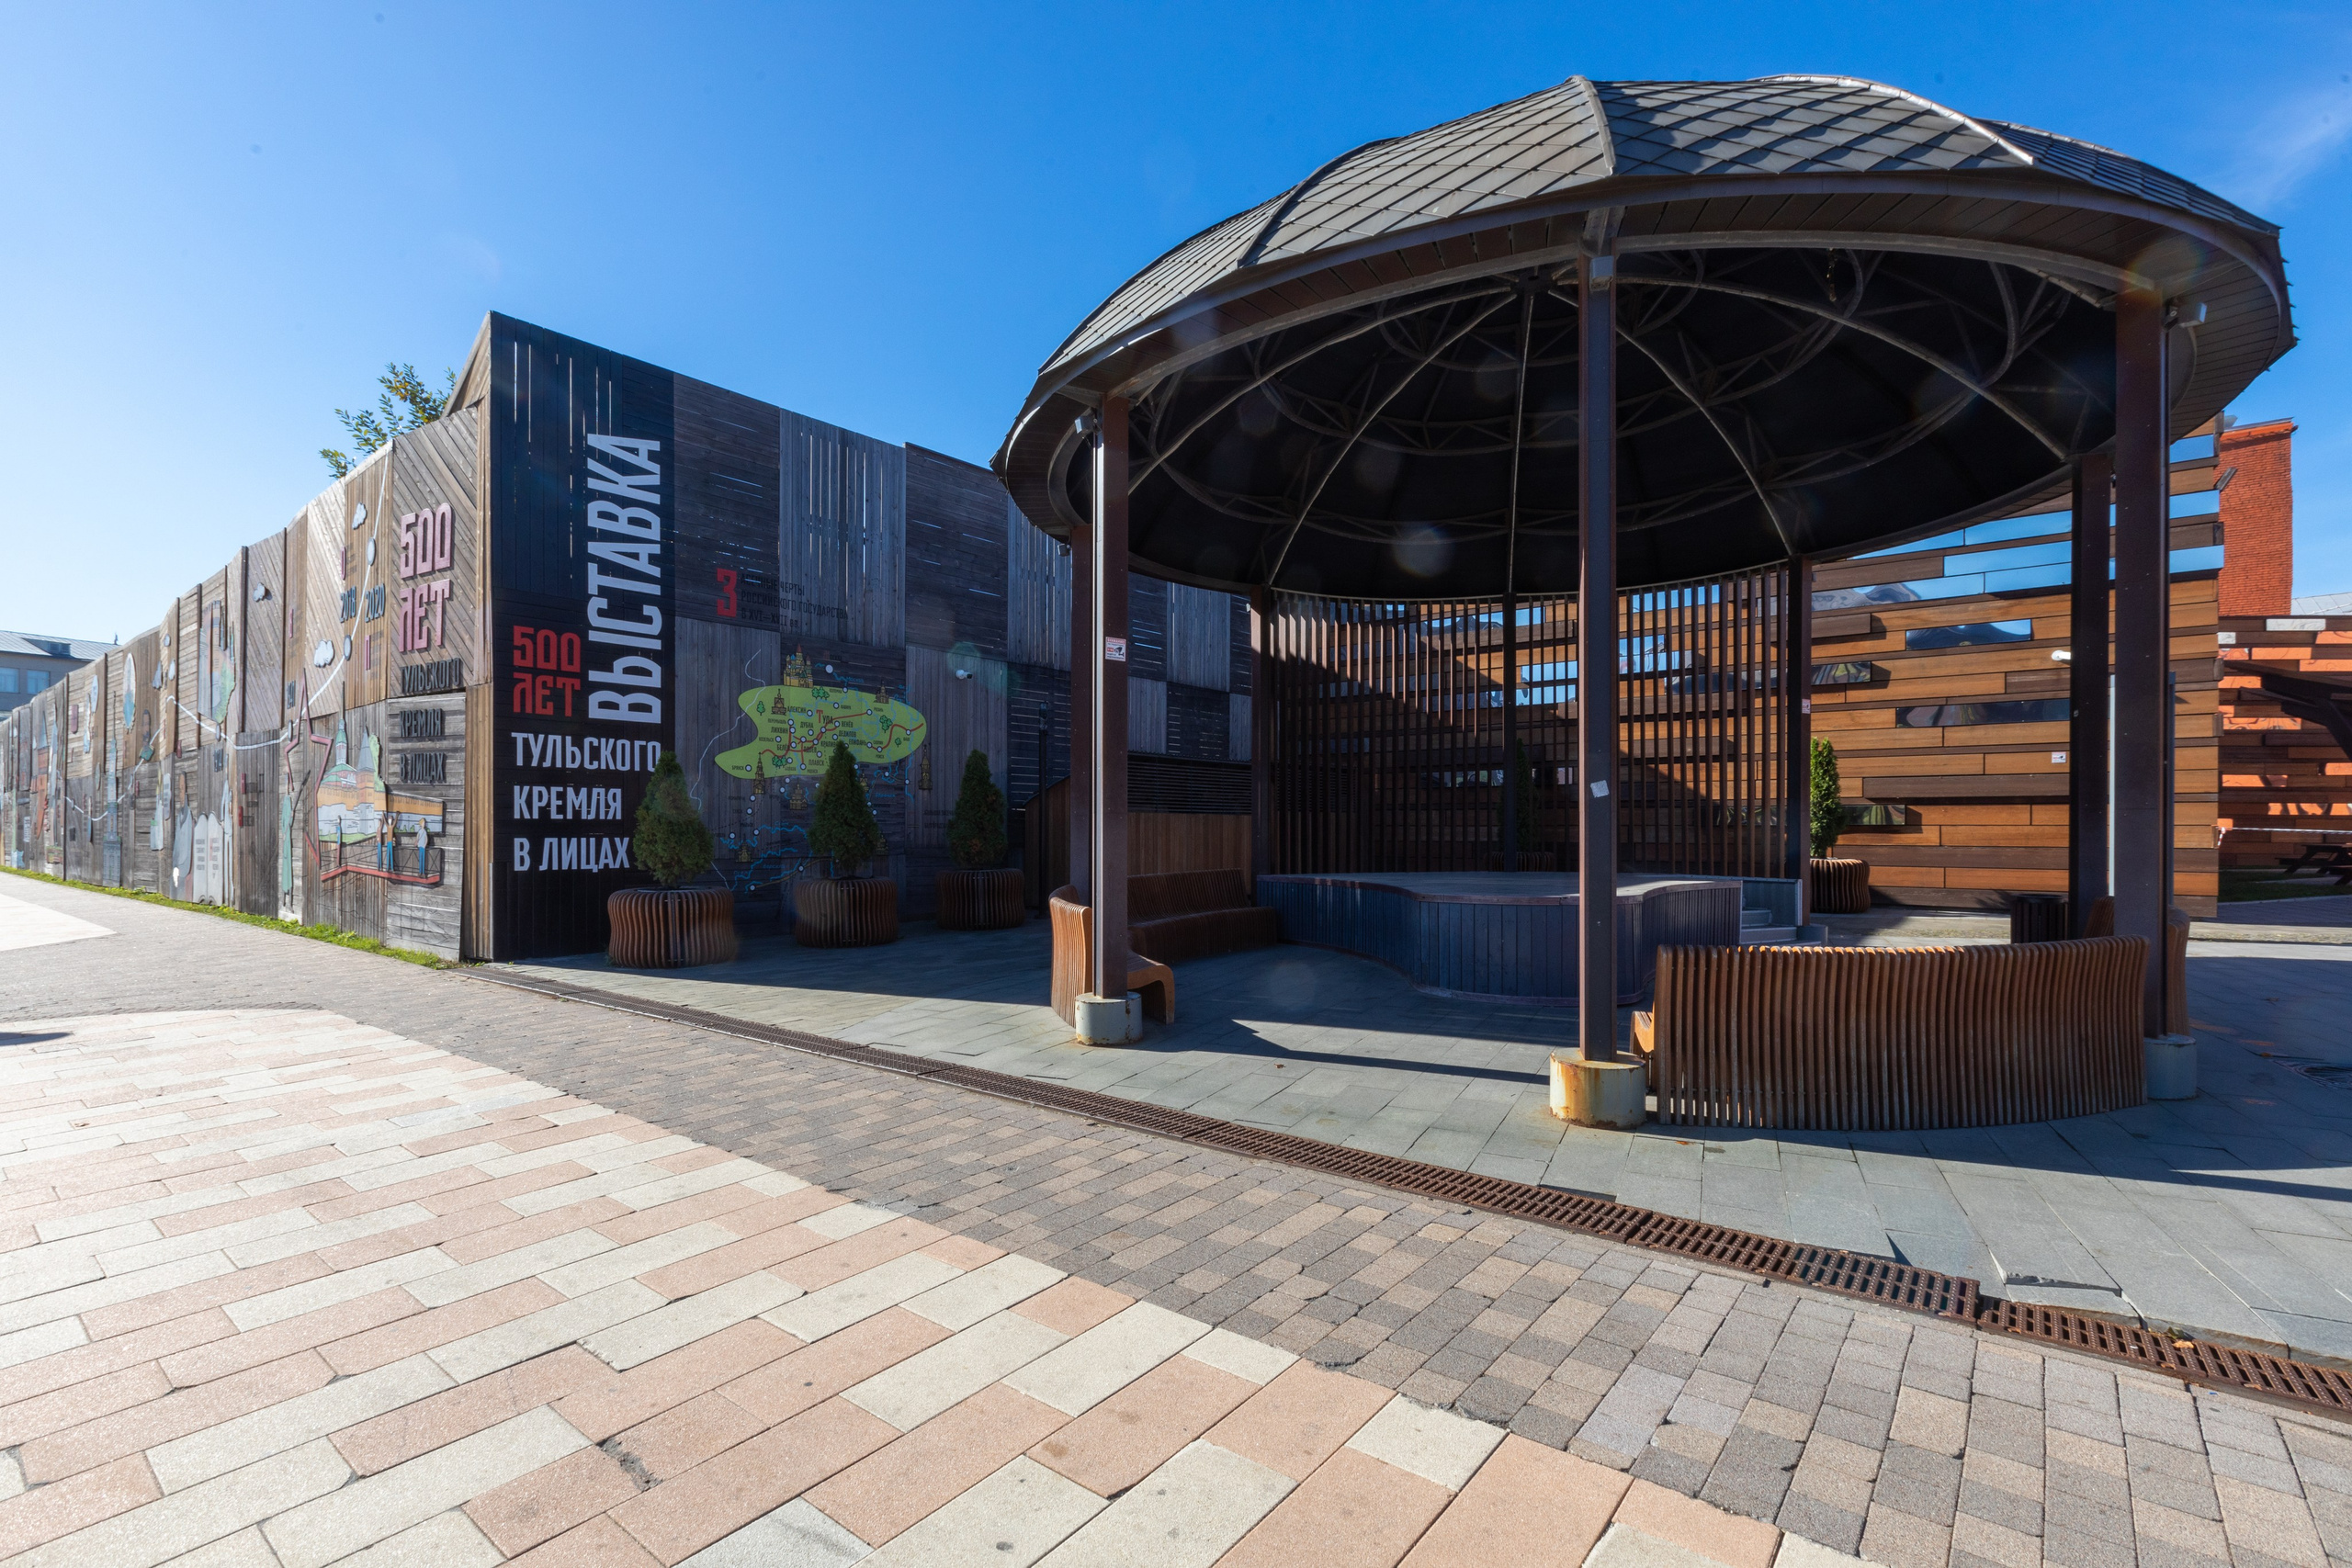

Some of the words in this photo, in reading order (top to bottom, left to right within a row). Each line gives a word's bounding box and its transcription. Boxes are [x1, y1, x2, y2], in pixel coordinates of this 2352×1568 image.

[400, 502, 453, 580] 500
[586, 433, 662, 724] ВЫСТАВКА
[781, 581, 805, 596] ЧЕРТЫ
[340, 585, 356, 624] 2018
[365, 582, 385, 623] 2020
[399, 578, 451, 652] ЛЕТ
[741, 590, 797, 612] РОССИЙСКОГО
[798, 601, 849, 619] ГОСУДАРСТВА
[513, 624, 582, 673] 500
[400, 657, 462, 694] ТУЛЬСКОГО
[513, 671, 582, 717] ЛЕТ
[399, 708, 443, 739] КРЕМЛЯ
[400, 752, 408, 782] В
[409, 751, 447, 786] ЛИЦАХ
[511, 731, 662, 773] ТУЛЬСКОГО
[513, 784, 622, 820] КРЕМЛЯ
[514, 836, 531, 873] В
[539, 836, 630, 874] ЛИЦАХ
